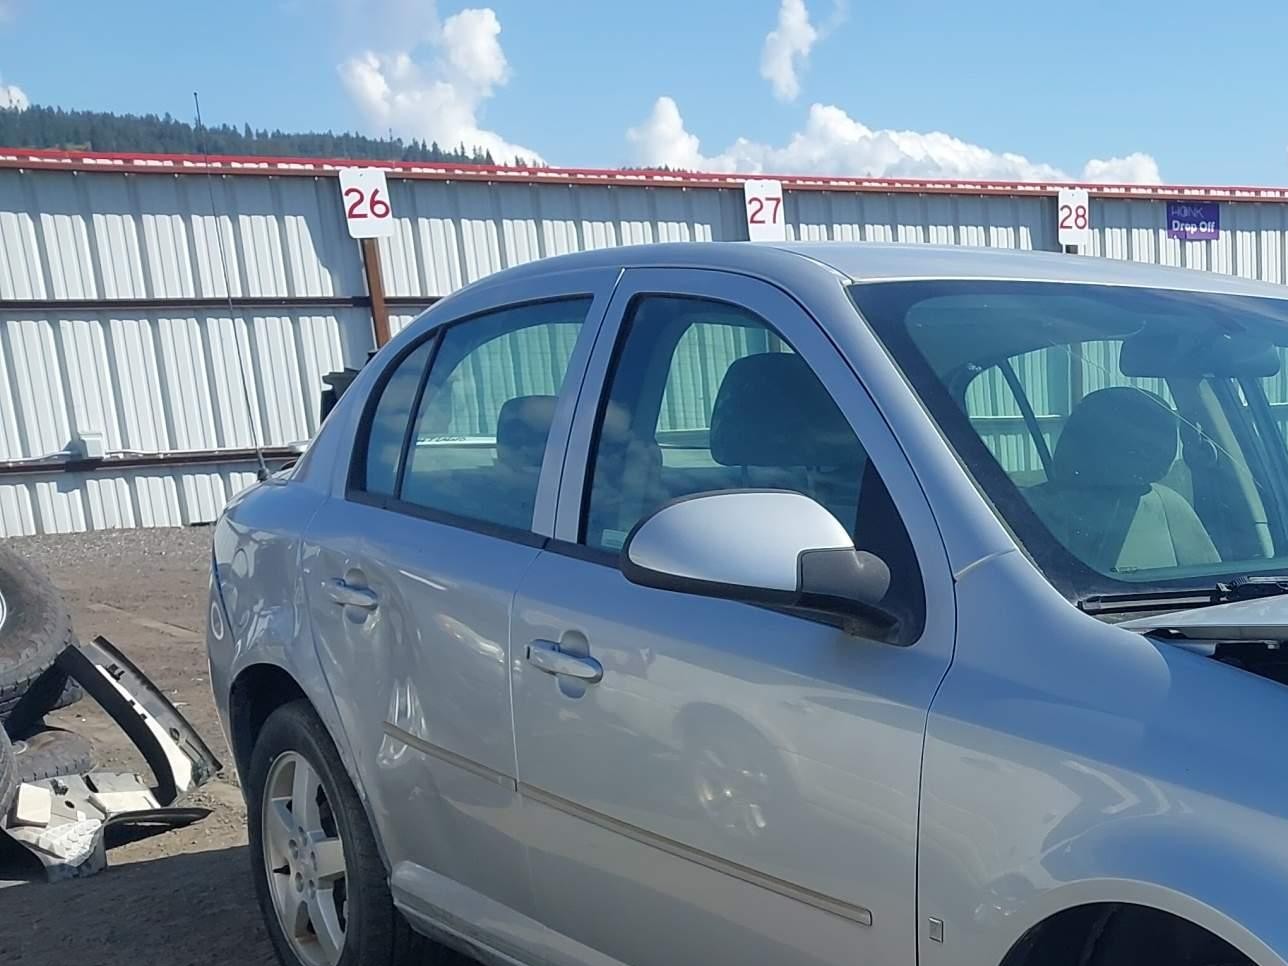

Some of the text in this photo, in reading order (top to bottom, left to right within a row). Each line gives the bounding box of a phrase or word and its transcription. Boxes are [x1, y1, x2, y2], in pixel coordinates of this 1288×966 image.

[344, 188, 390, 219] 26
[748, 197, 781, 224] 27
[1060, 204, 1087, 229] 28
[1172, 220, 1216, 234] Drop Off
